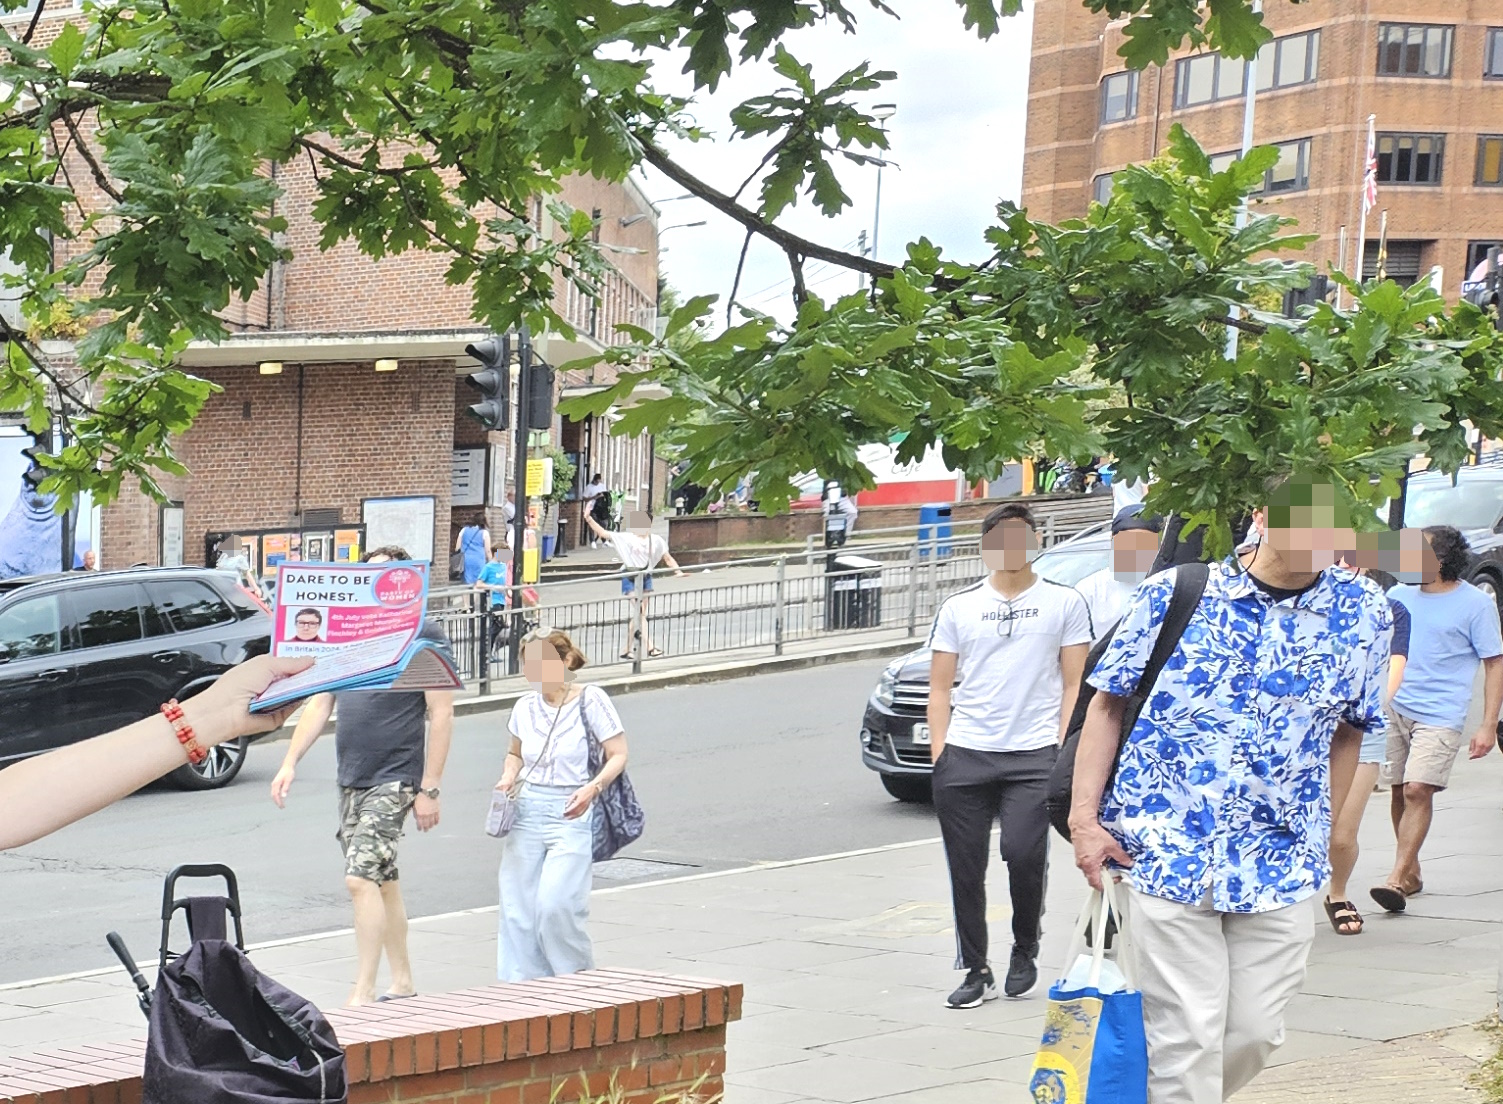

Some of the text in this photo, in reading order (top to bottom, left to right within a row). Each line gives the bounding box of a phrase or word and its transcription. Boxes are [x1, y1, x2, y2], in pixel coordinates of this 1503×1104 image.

[286, 574, 371, 585] DARE TO BE
[296, 591, 358, 602] HONEST.
